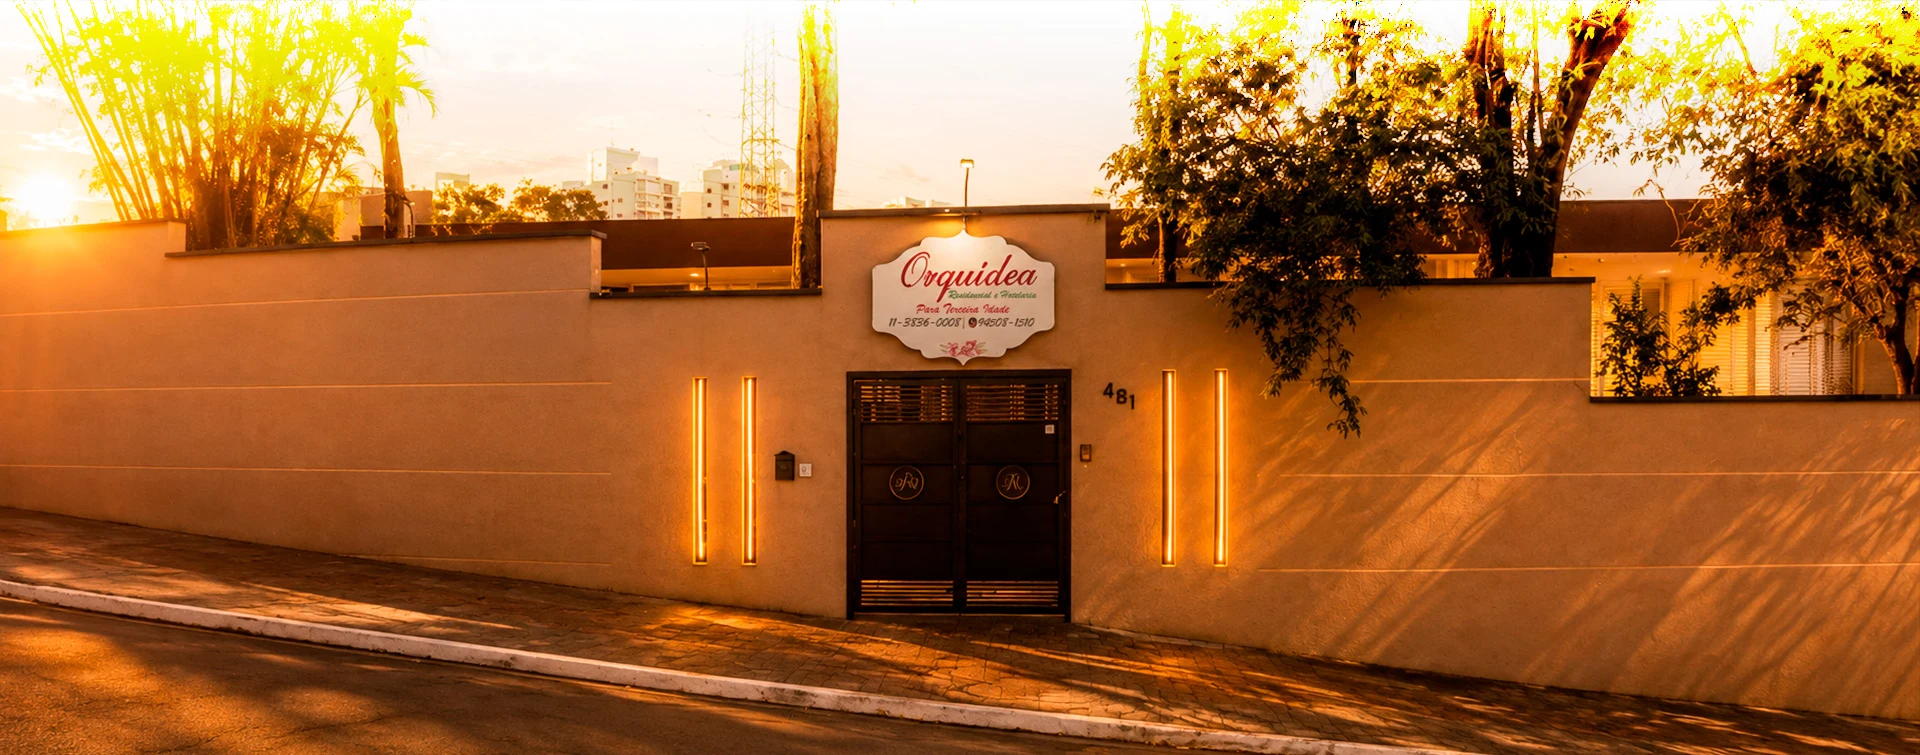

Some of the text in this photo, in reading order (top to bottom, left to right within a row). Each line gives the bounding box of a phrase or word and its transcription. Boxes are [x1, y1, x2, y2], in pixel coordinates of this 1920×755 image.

[948, 289, 992, 299] Residencial
[1000, 290, 1037, 299] Hotelaria
[916, 303, 1010, 315] Para Terceira Idade
[888, 317, 1035, 328] 11-3836-0008 94508-1510
[1103, 382, 1135, 410] 481
